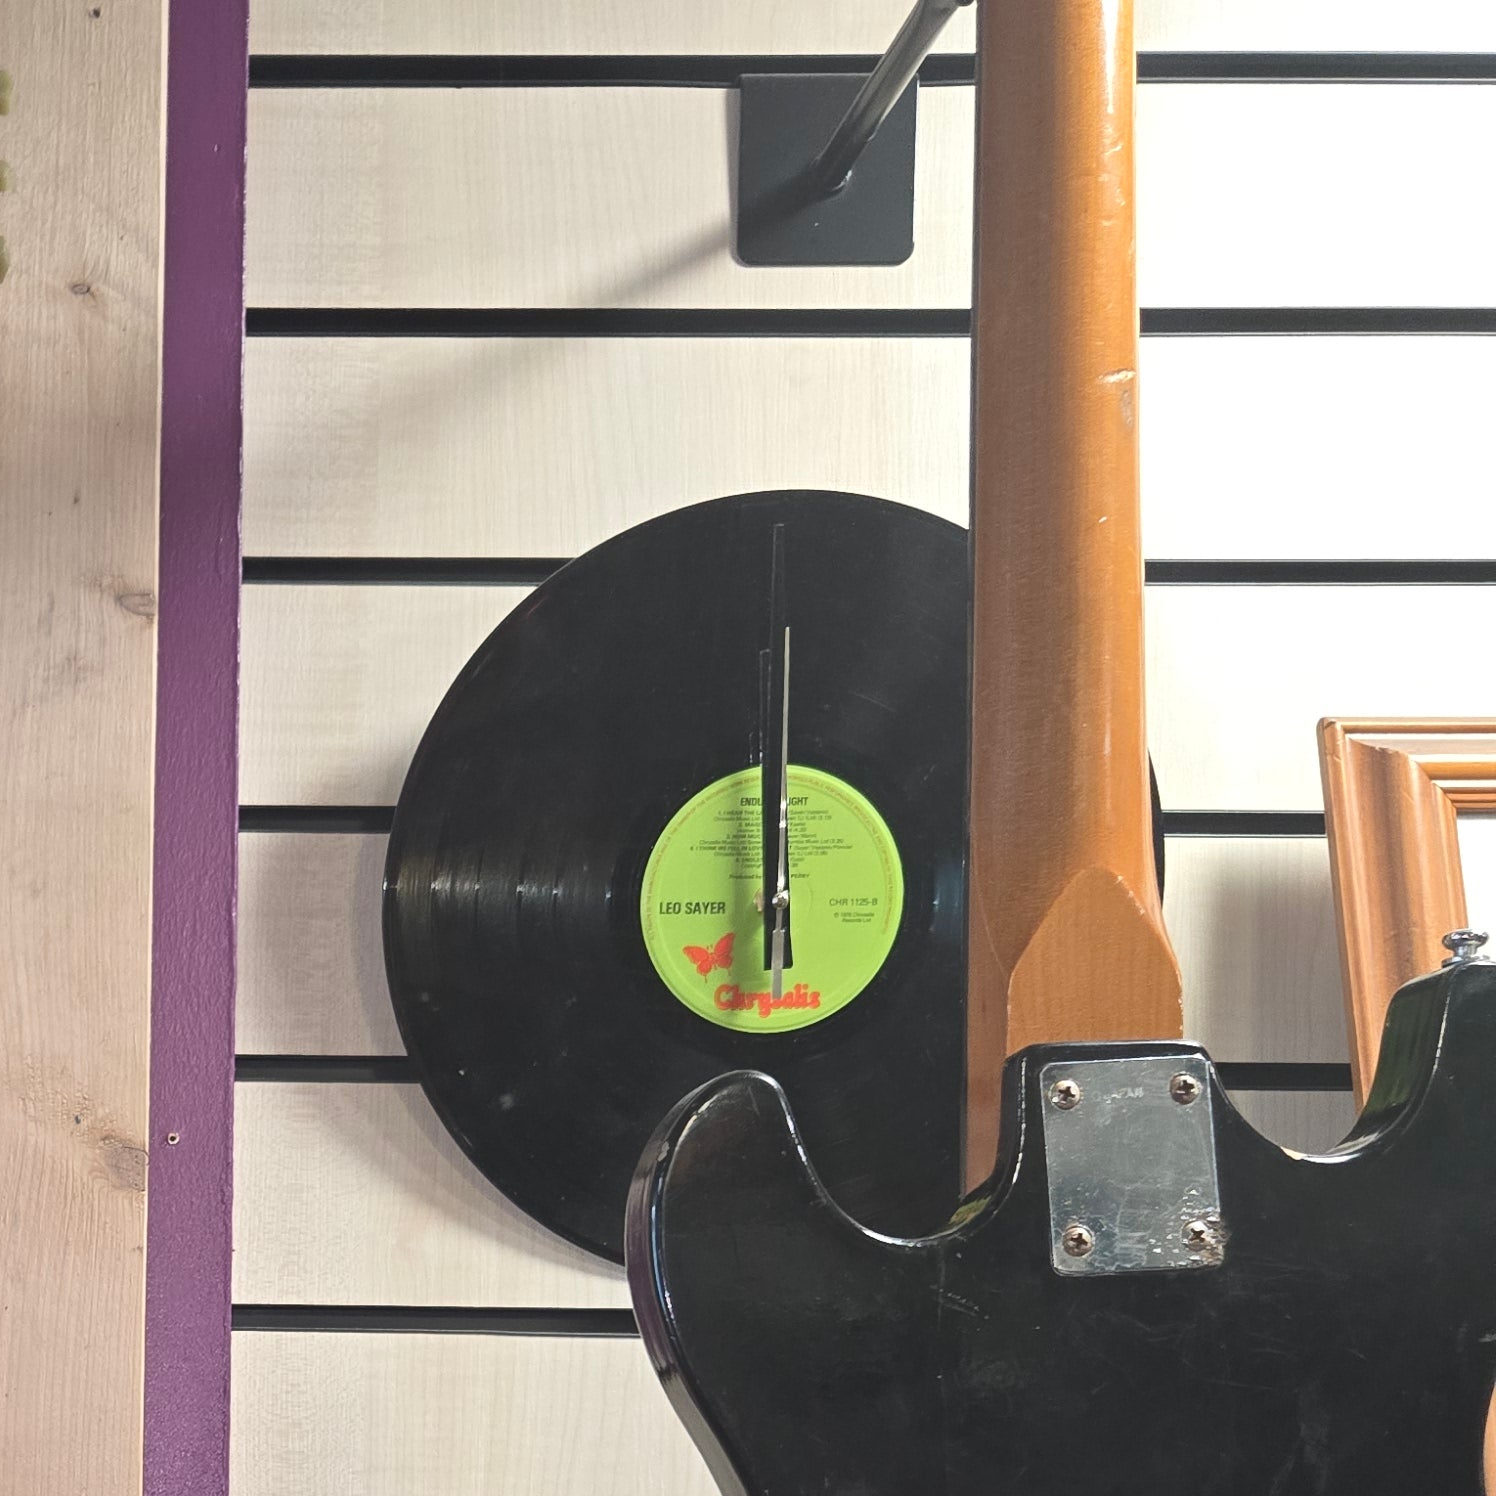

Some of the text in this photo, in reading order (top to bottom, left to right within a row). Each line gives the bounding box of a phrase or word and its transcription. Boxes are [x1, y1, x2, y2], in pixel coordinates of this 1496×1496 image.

[829, 897, 848, 906] CHR
[659, 902, 726, 915] LEO SAYER
